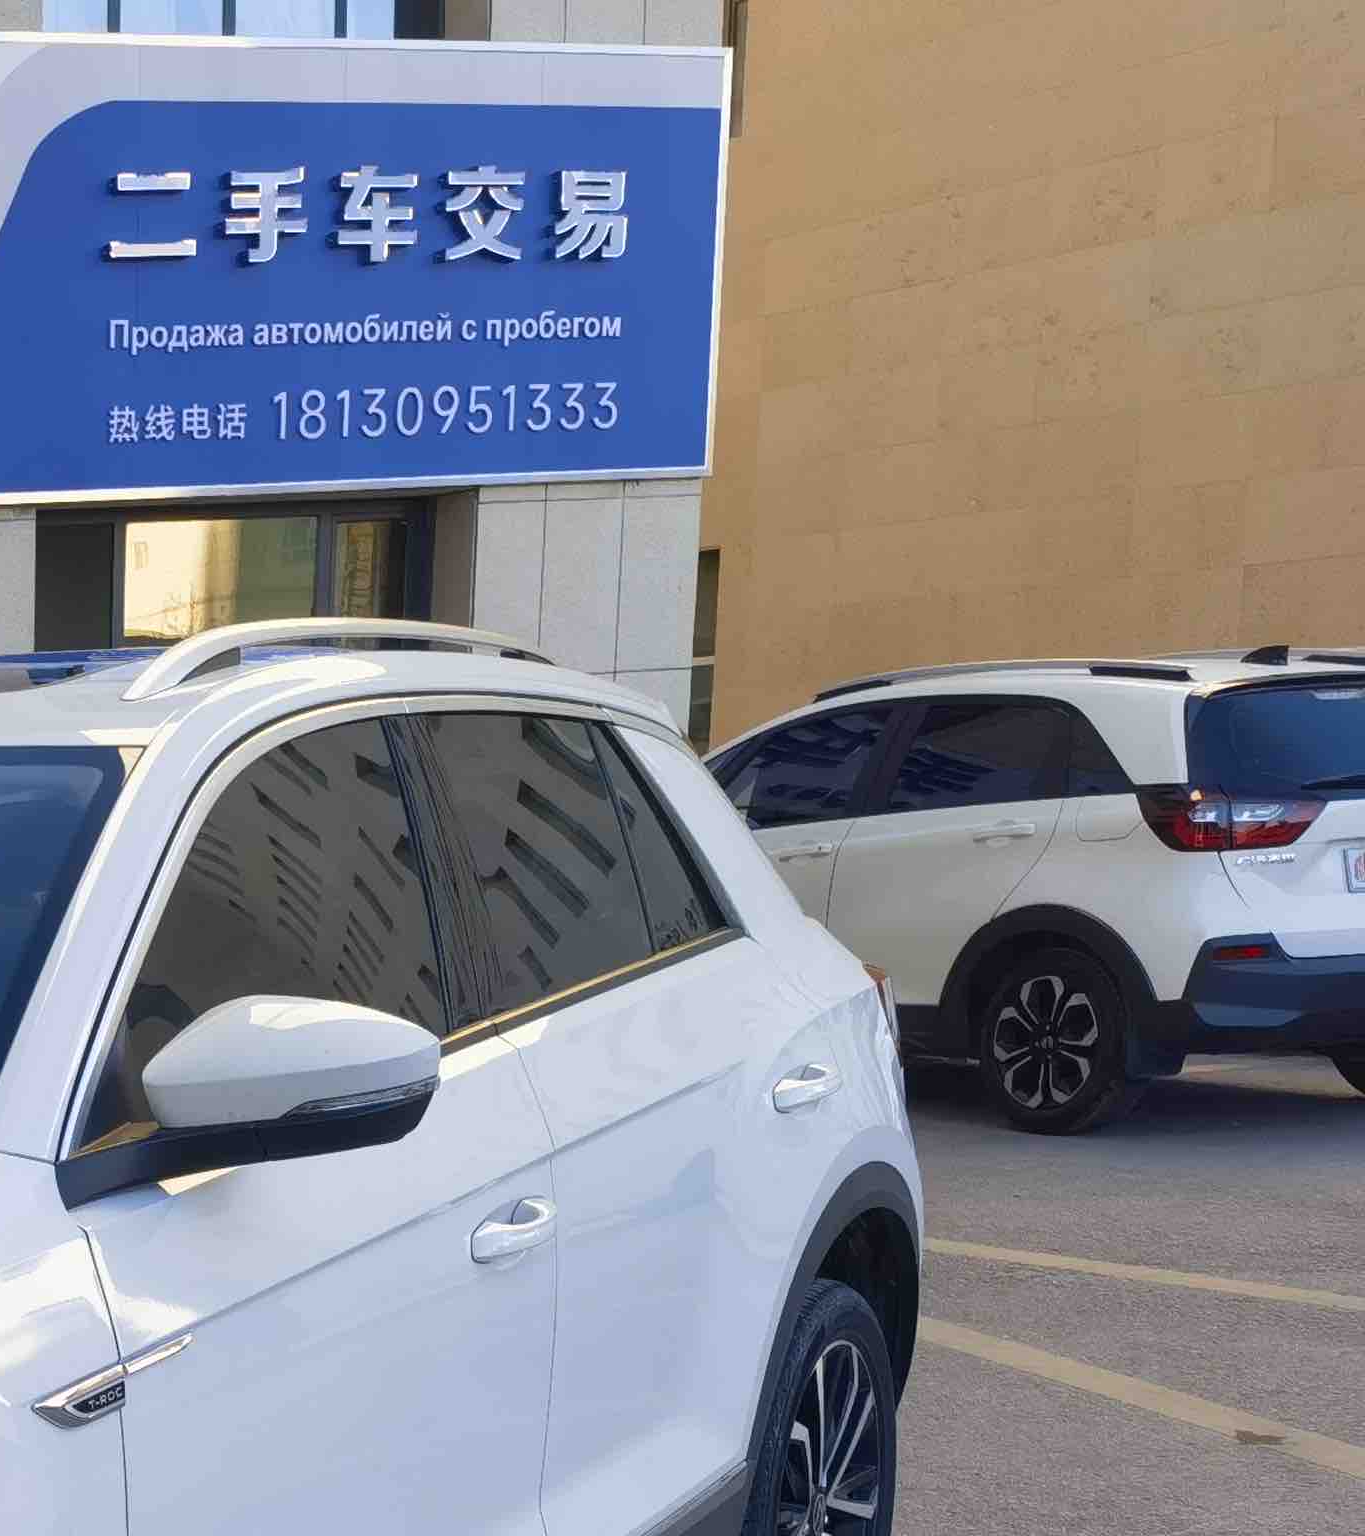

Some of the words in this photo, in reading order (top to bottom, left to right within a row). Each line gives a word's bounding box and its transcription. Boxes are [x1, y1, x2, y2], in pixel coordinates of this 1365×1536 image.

[110, 165, 628, 263] 二手车交易
[109, 319, 244, 355] Продажа
[253, 313, 452, 345] автомобилей
[461, 319, 478, 341] с
[486, 310, 622, 347] пробегом
[108, 403, 247, 443] 热线电话
[272, 381, 619, 440] 18130951333
